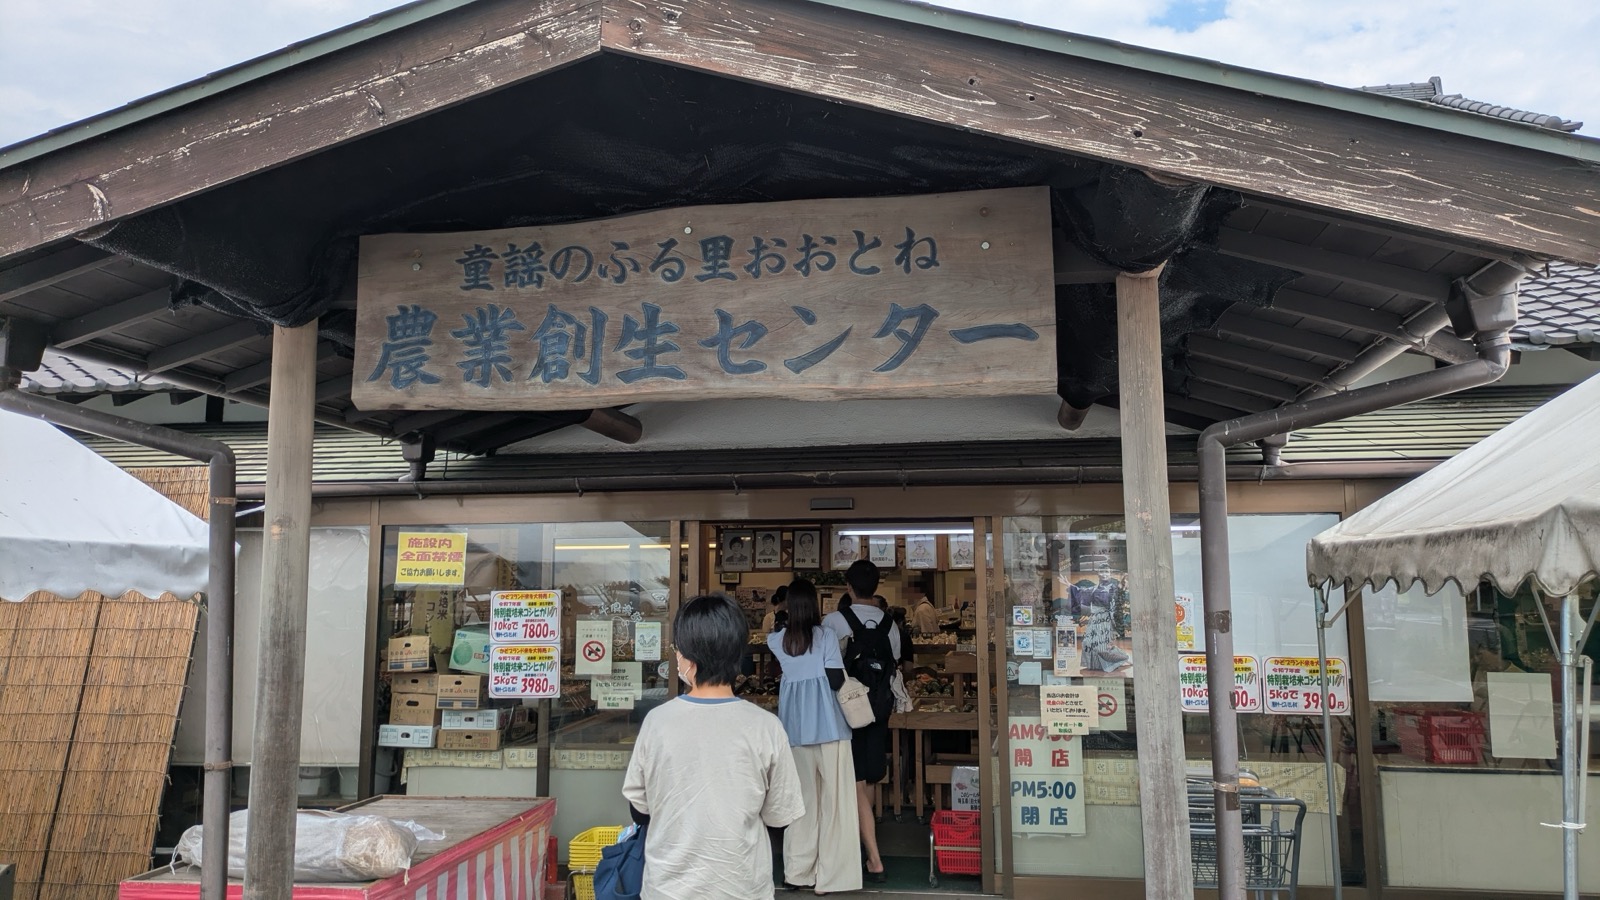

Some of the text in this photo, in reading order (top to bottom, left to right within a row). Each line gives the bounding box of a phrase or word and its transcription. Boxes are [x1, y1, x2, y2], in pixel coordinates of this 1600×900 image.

[456, 227, 940, 292] 童謡のふる里おおとね
[367, 301, 1040, 389] 農業創生センター
[407, 537, 452, 549] 施設内
[400, 550, 464, 563] 全面禁煙
[1269, 690, 1298, 700] 5kgで
[1303, 692, 1345, 710] 390円
[1011, 781, 1077, 800] PM5:00
